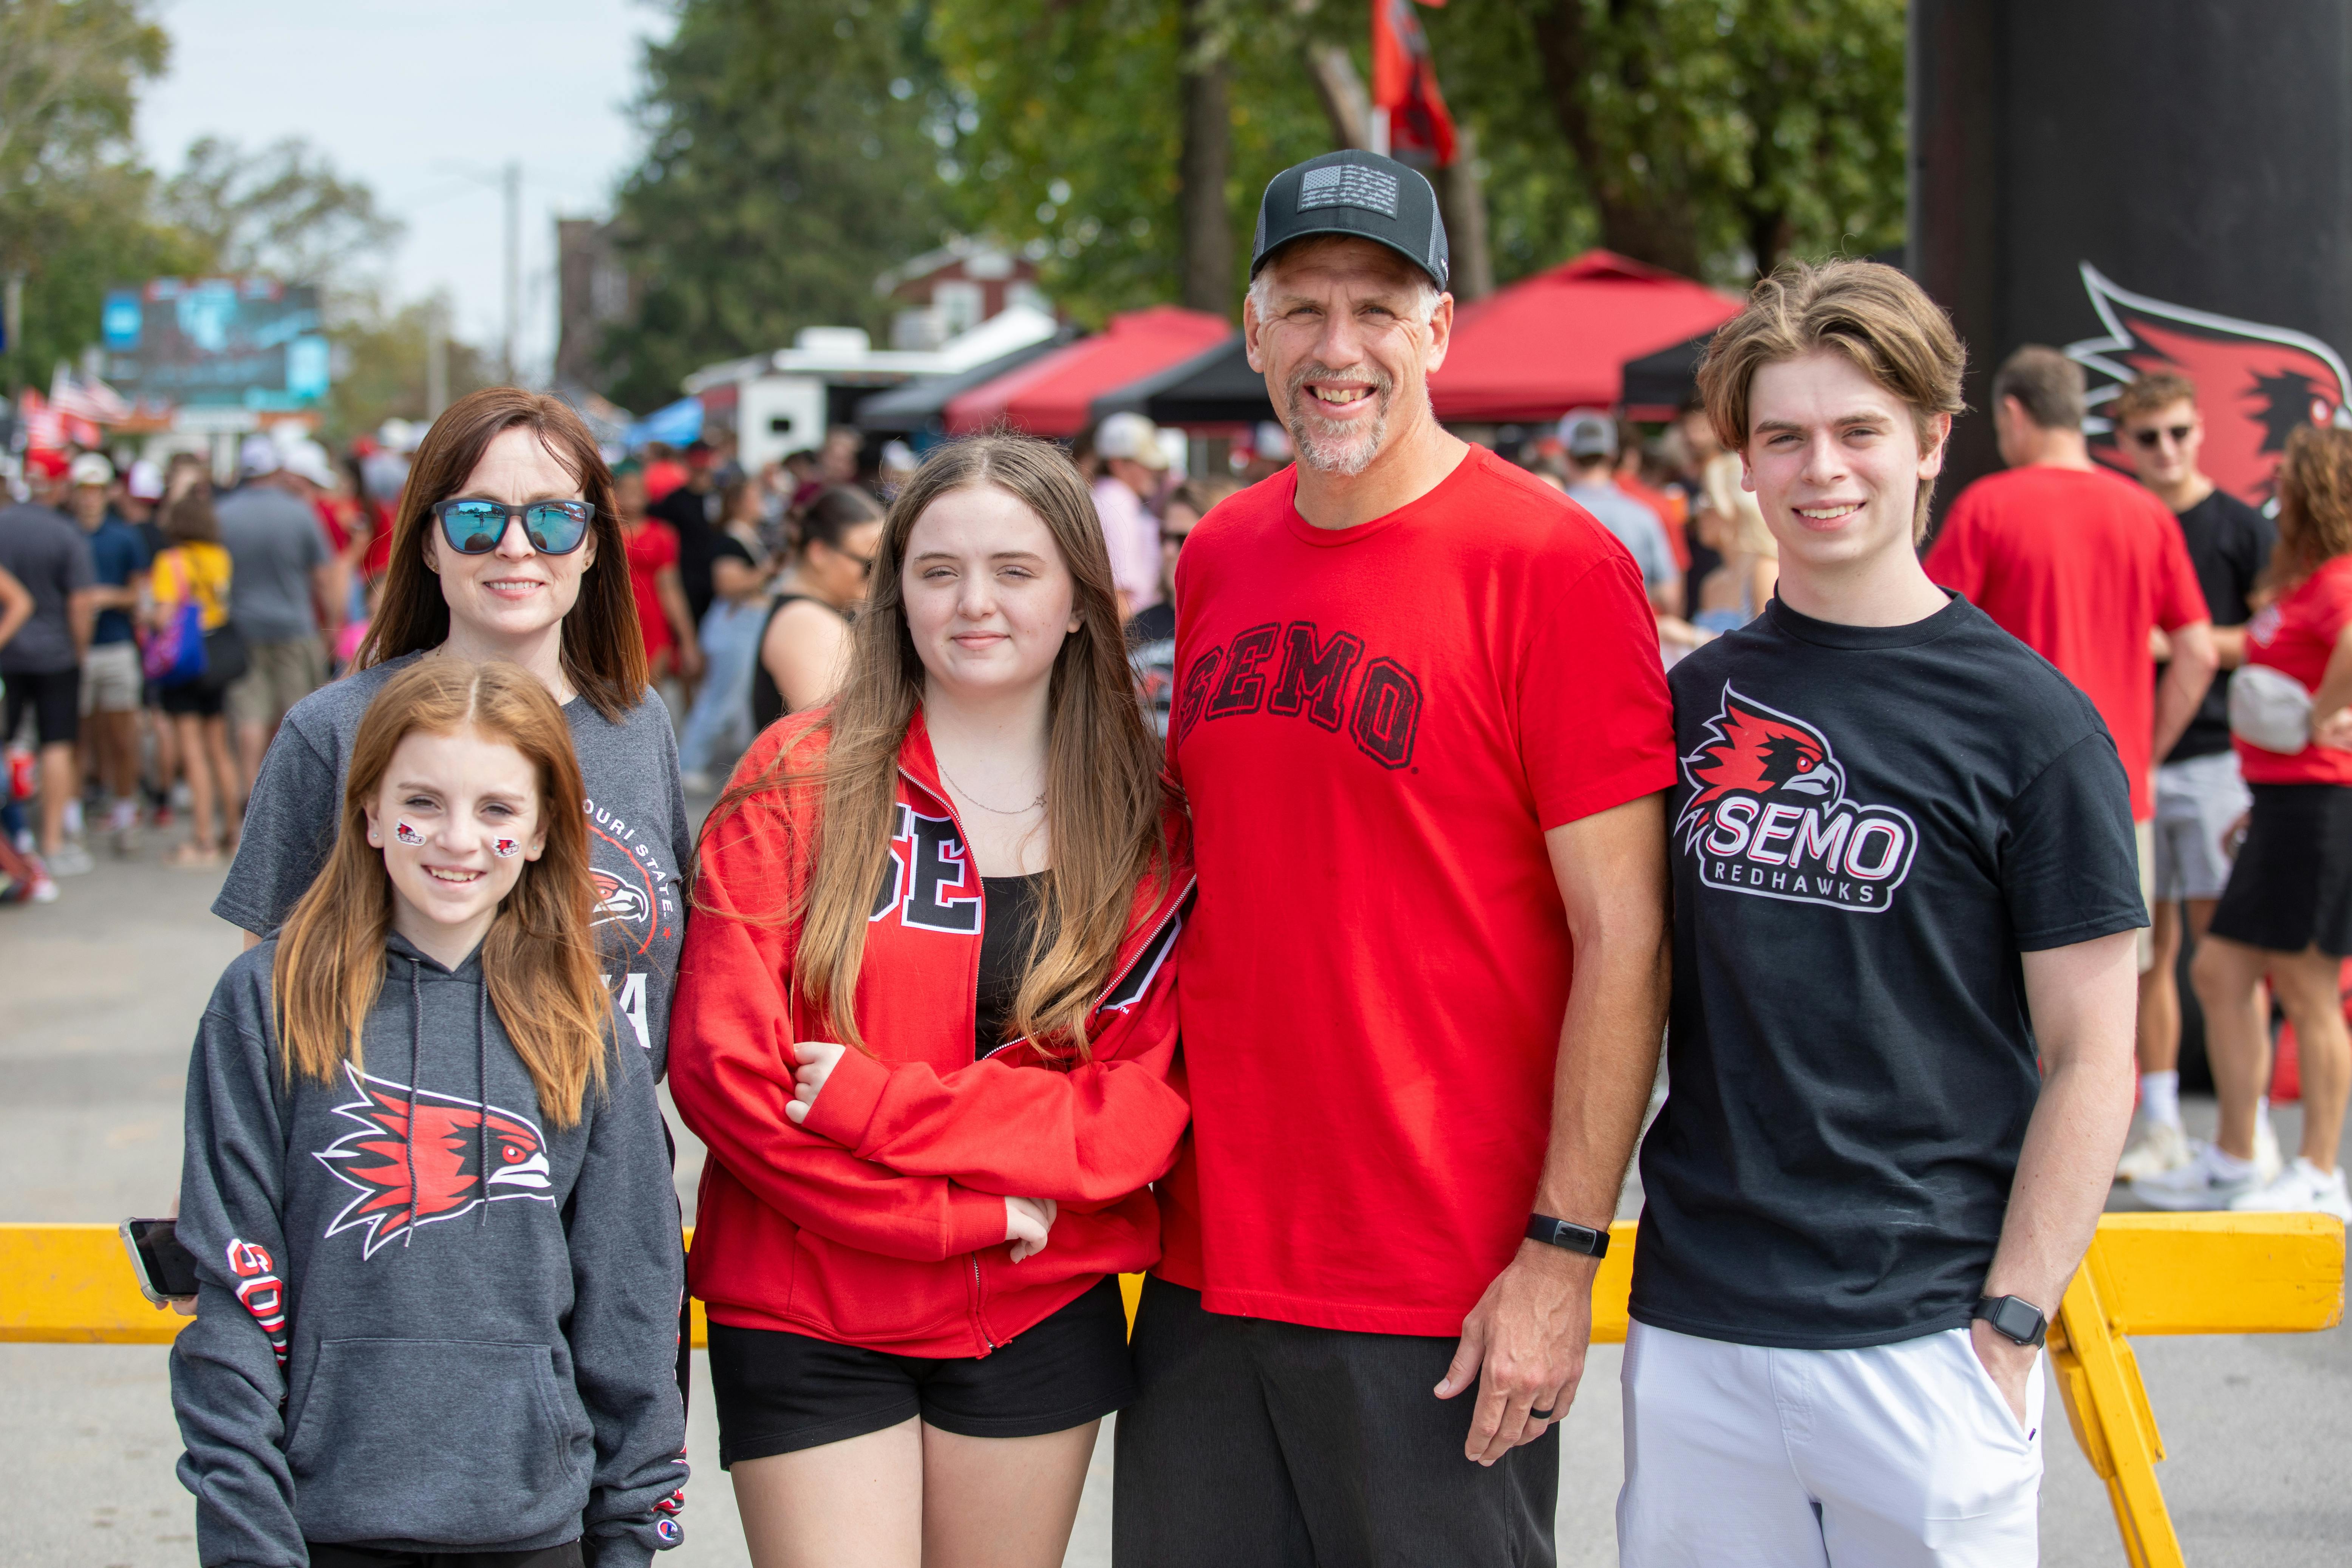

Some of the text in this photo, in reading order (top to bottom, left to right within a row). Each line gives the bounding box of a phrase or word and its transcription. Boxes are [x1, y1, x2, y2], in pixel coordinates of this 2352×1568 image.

[1179, 621, 1423, 770] SEMO
[400, 834, 424, 844] SEMO
[583, 798, 635, 840] OURI
[1705, 796, 1906, 880] SEMO
[502, 845, 520, 855] SEM
[1715, 864, 1874, 903] REDHAWKS
